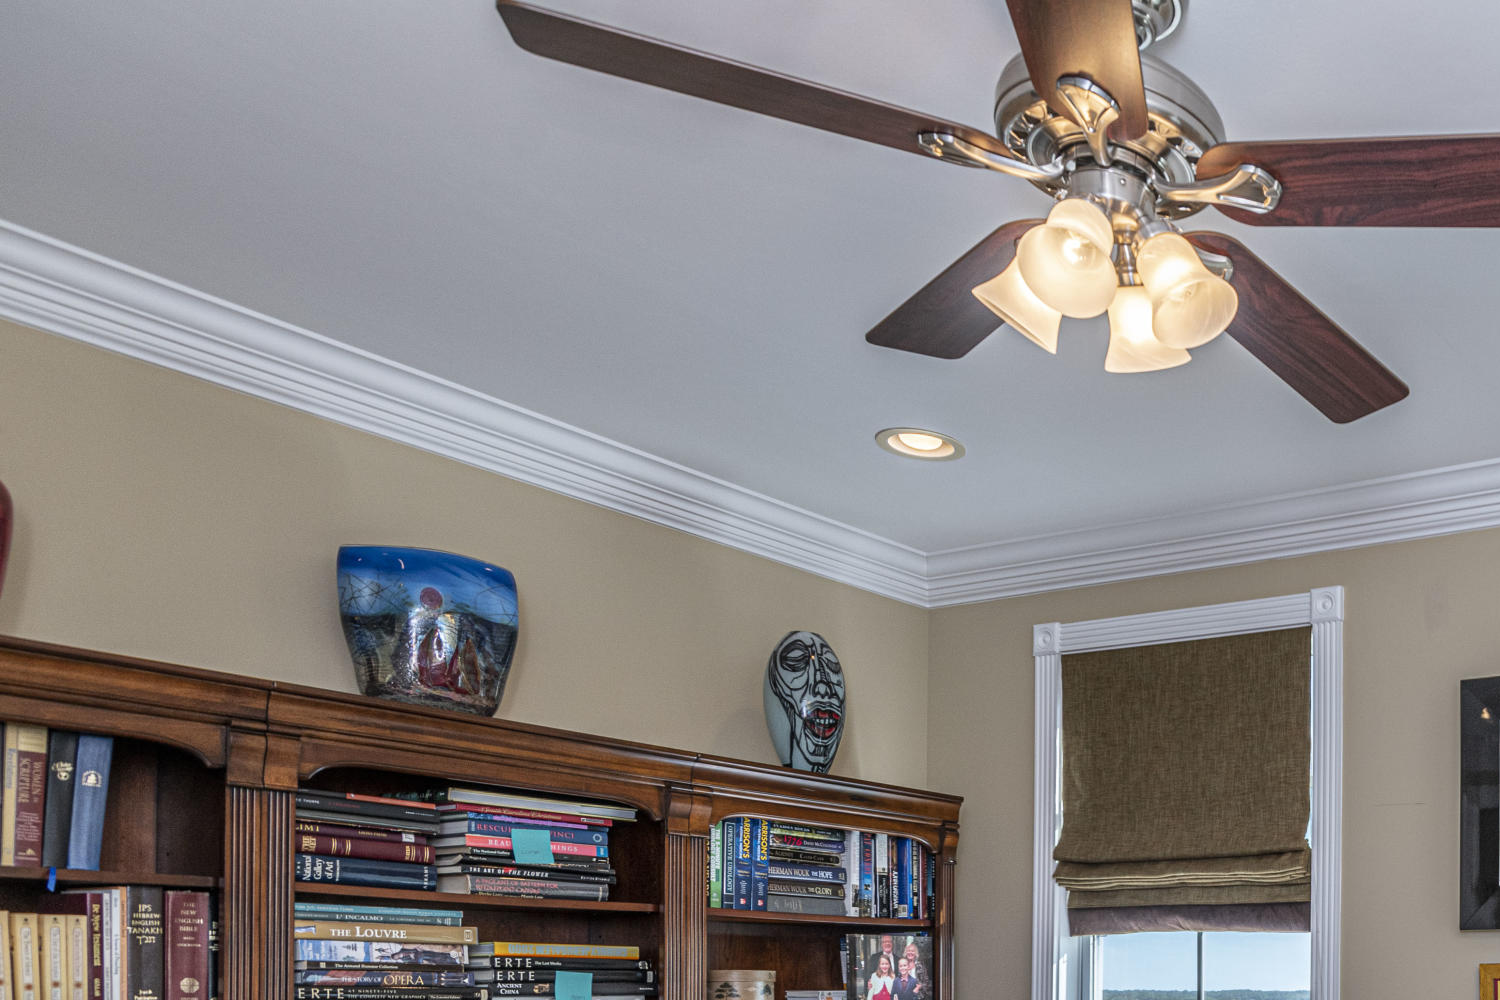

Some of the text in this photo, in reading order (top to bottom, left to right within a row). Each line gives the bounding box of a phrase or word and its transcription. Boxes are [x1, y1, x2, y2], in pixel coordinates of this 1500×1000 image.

[476, 824, 512, 833] RESCUI
[742, 817, 751, 858] ARRISON'S
[760, 820, 768, 861] ARRISON'S
[784, 835, 803, 847] 1776
[302, 855, 312, 880] National
[314, 858, 325, 880] Gallery
[768, 867, 792, 875] HERMAN
[819, 870, 833, 879] HOPE
[815, 887, 832, 896] GLORY
[138, 904, 152, 912] JPS
[330, 926, 407, 938] THE LOUVRE
[494, 958, 532, 968] ERTE
[384, 975, 424, 986] OPERA
[497, 971, 535, 981] ERTE
[298, 988, 344, 999] ERTE
